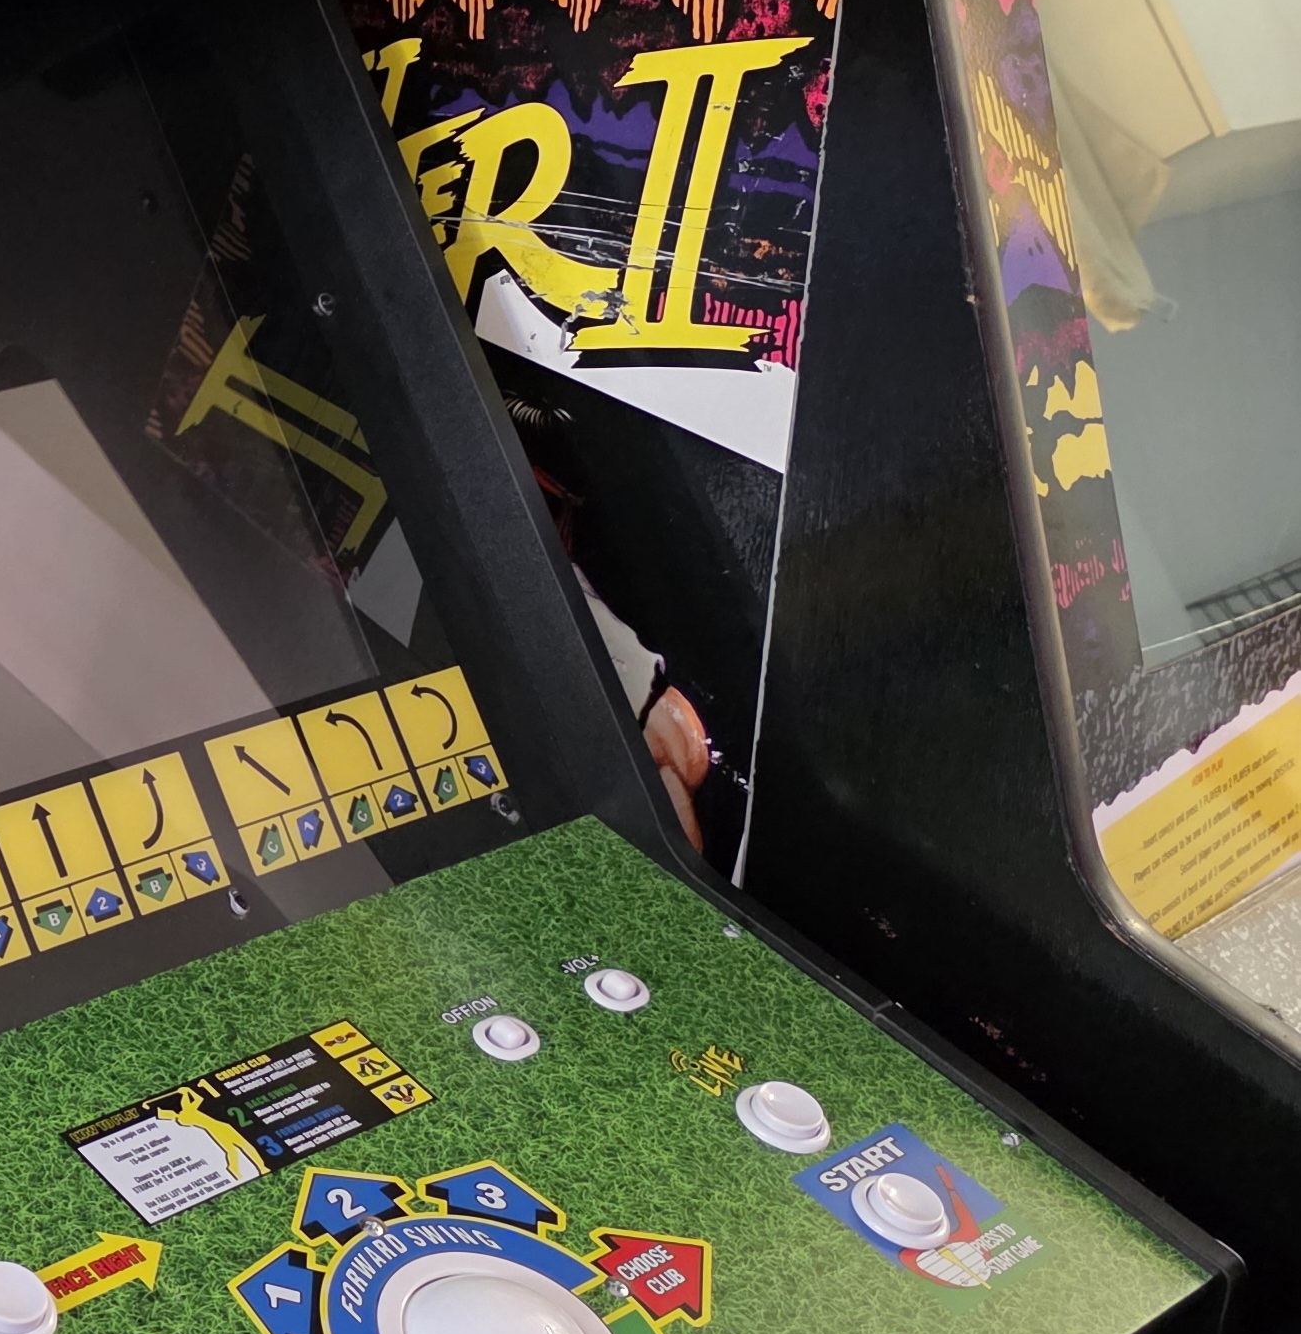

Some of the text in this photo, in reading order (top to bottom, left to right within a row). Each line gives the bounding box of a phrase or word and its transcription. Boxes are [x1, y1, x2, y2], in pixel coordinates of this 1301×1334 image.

[442, 762, 487, 793] C 3
[357, 794, 403, 823] C 2
[268, 820, 315, 854] C 1
[150, 858, 207, 894] B 3
[48, 897, 109, 927] B 2
[441, 996, 498, 1025] OFF/ON
[688, 1044, 745, 1097] LIVE
[197, 1079, 221, 1098] 1
[227, 1106, 254, 1128] 2
[257, 1134, 284, 1156] 3
[817, 1137, 905, 1194] START
[326, 1187, 366, 1220] 2
[475, 1183, 508, 1209] 3
[970, 1223, 1016, 1254] PRESS TO
[616, 1244, 675, 1282] CHOOSE
[986, 1235, 1043, 1274] START GAME
[44, 1244, 146, 1300] FACE RIGHT
[341, 1224, 503, 1324] FORWARD SWING
[645, 1267, 687, 1296] CLUB
[264, 1284, 302, 1309] 1
